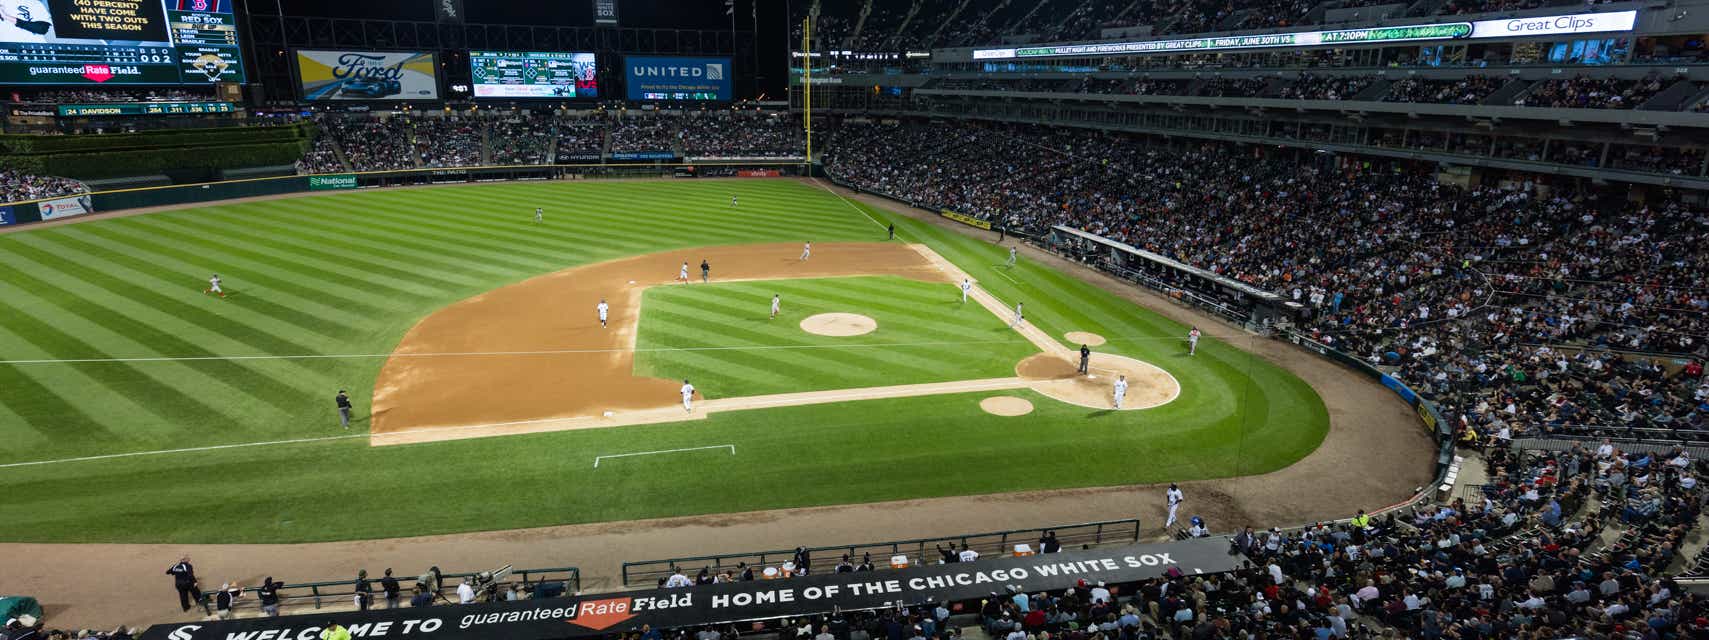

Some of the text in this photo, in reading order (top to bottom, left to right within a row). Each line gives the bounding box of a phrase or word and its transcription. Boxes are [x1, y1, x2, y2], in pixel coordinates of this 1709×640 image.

[1507, 15, 1594, 32] Great Clips
[1098, 44, 1125, 52] FIREWORKS
[1126, 43, 1156, 51] PRESENTED
[1165, 41, 1184, 49] GREAT
[1185, 40, 1202, 48] CLIPS
[1215, 39, 1241, 47] FRIDAY,
[1243, 37, 1259, 45] JUNE
[1260, 36, 1280, 45] 30TH
[1281, 36, 1290, 44] VS
[1326, 33, 1338, 41] AT
[1338, 31, 1368, 41] 7:10PM
[140, 55, 171, 63] 0 0 2
[333, 53, 404, 80] Ford
[29, 66, 85, 75] guaranteed
[86, 66, 109, 74] Rate
[634, 66, 702, 77] UNITED
[320, 177, 356, 185] National
[712, 552, 1177, 609] HOME OF THE CHICAGO WHITE SOX
[459, 593, 693, 629] guaranteed Rate Field
[402, 618, 443, 634] TO
